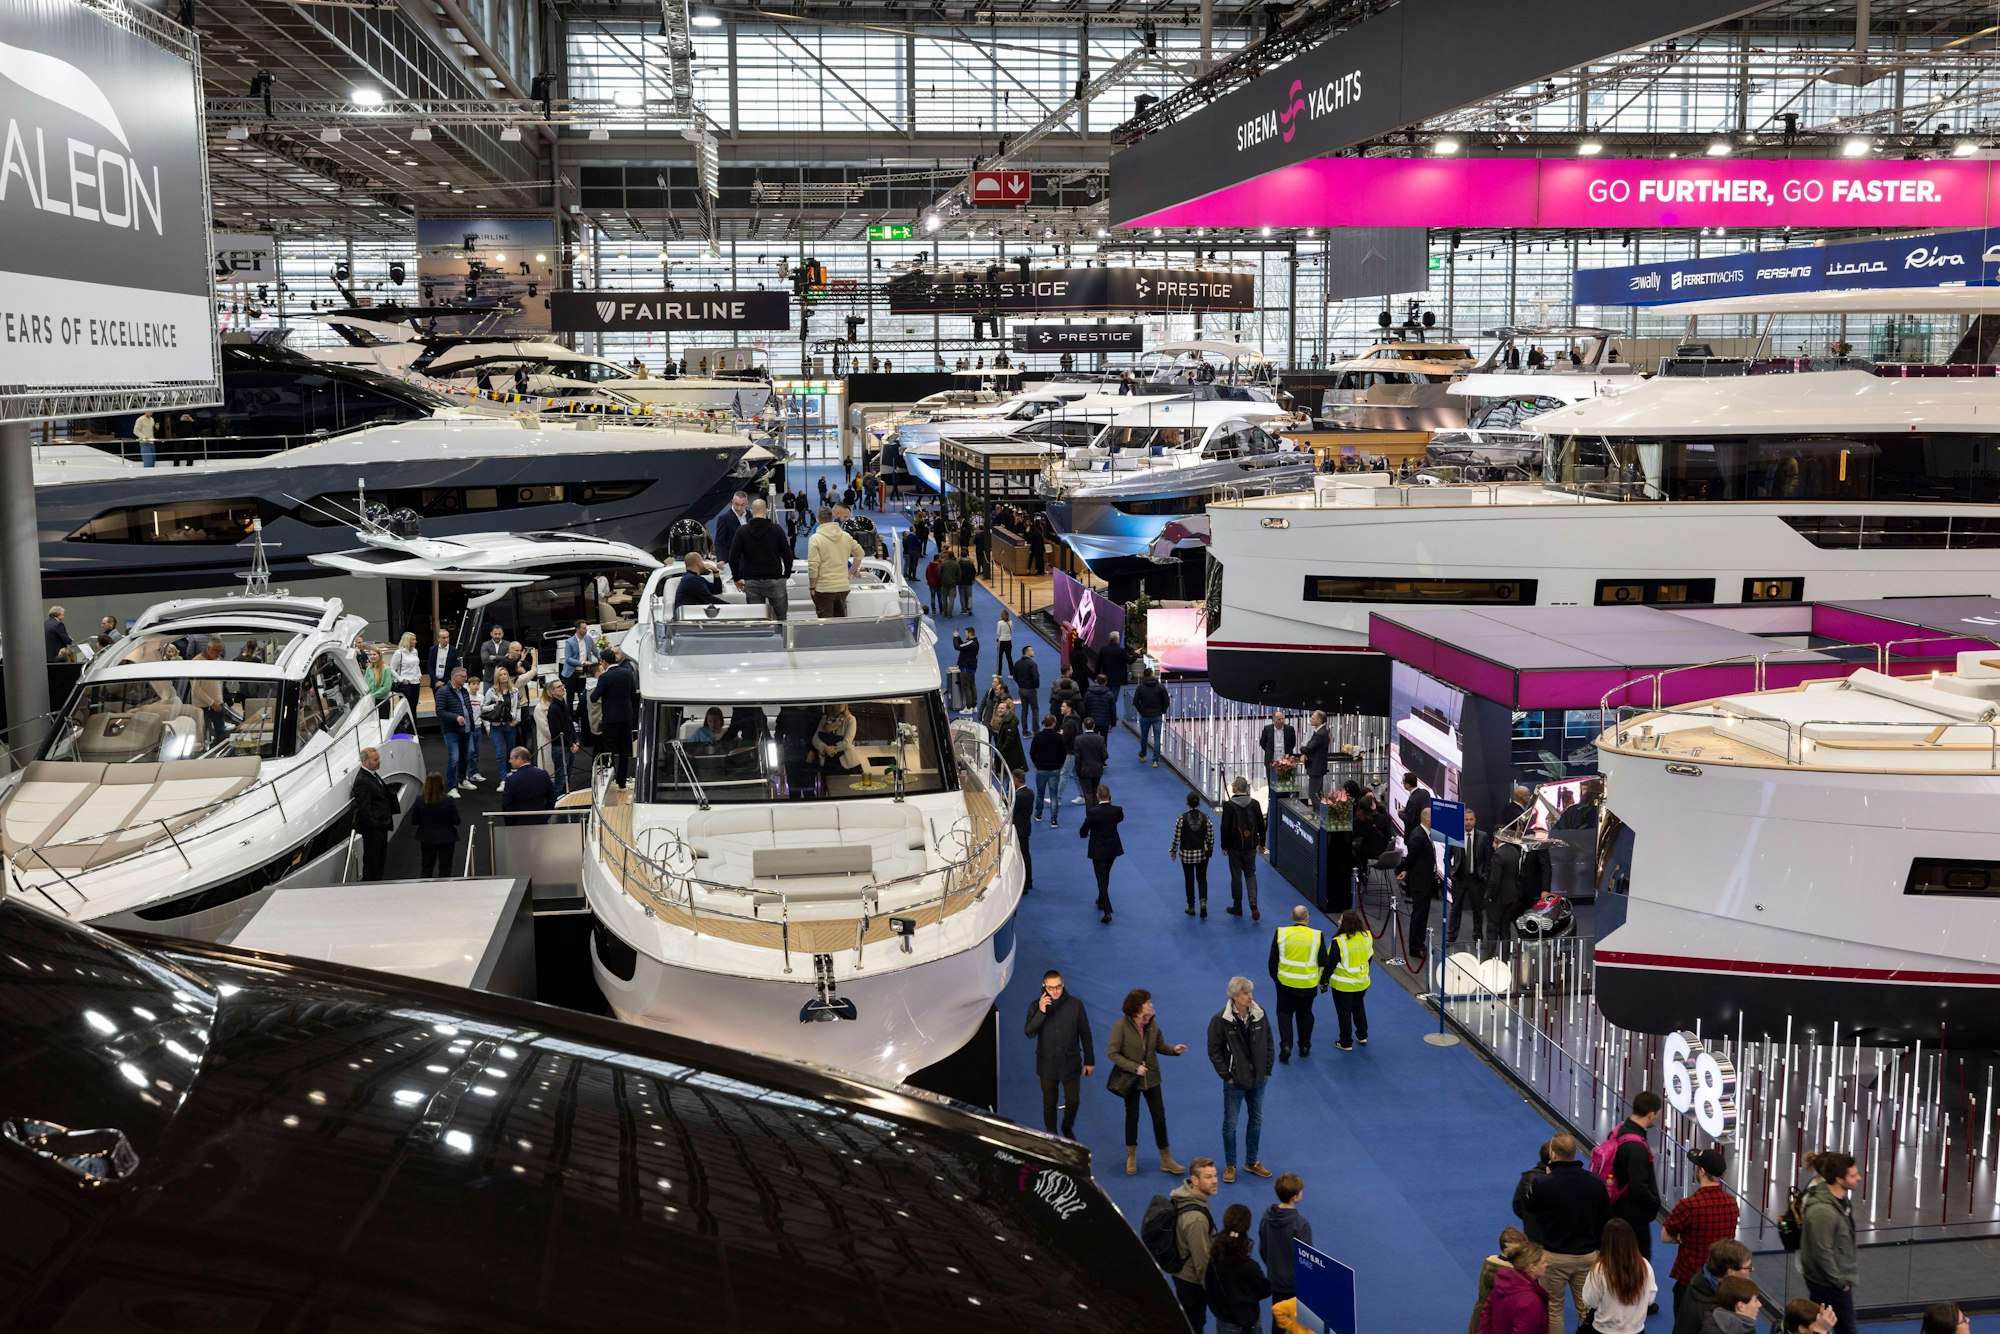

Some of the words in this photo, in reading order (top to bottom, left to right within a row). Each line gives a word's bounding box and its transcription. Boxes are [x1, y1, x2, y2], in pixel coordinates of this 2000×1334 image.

[1237, 109, 1278, 152] SIRENA
[1308, 69, 1362, 121] YACHTS
[1588, 179, 1631, 203] GO
[1638, 179, 1775, 206] FURTHER,
[1783, 179, 1824, 203] GO
[1832, 179, 1942, 203] FASTER.
[1904, 246, 1965, 269] Riva
[1638, 271, 1661, 291] wally
[1756, 265, 1812, 280] PERSHING
[621, 302, 746, 320] FAIRLINE
[0, 312, 53, 344] EARS
[61, 317, 82, 346] OF
[90, 319, 177, 348] EXCELLENCE
[1663, 1030, 1732, 1138] 68
